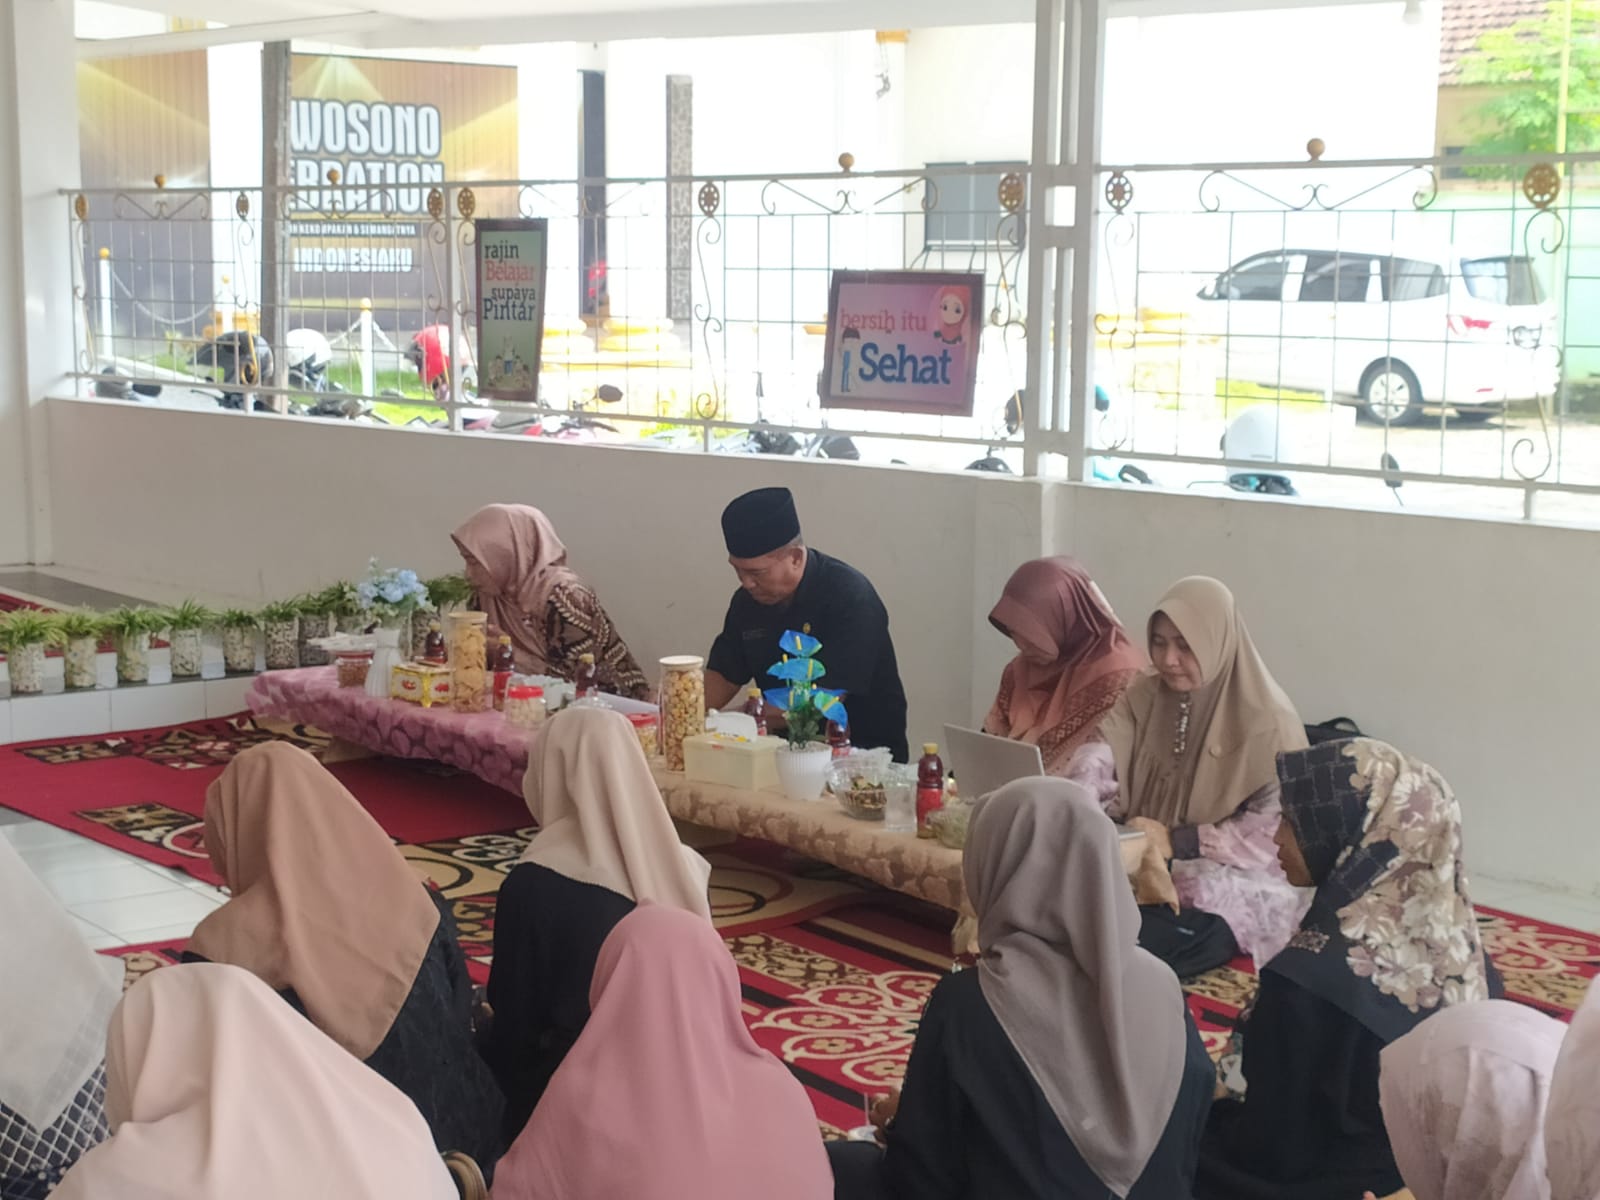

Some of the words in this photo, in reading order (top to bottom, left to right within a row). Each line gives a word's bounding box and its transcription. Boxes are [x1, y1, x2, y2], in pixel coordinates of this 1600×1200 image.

[484, 240, 519, 263] rajin
[485, 261, 535, 284] Belajar
[491, 287, 536, 304] supaya
[483, 298, 535, 321] Pintar
[840, 307, 896, 331] bersih
[901, 311, 927, 332] itu
[858, 342, 952, 385] Sehat
